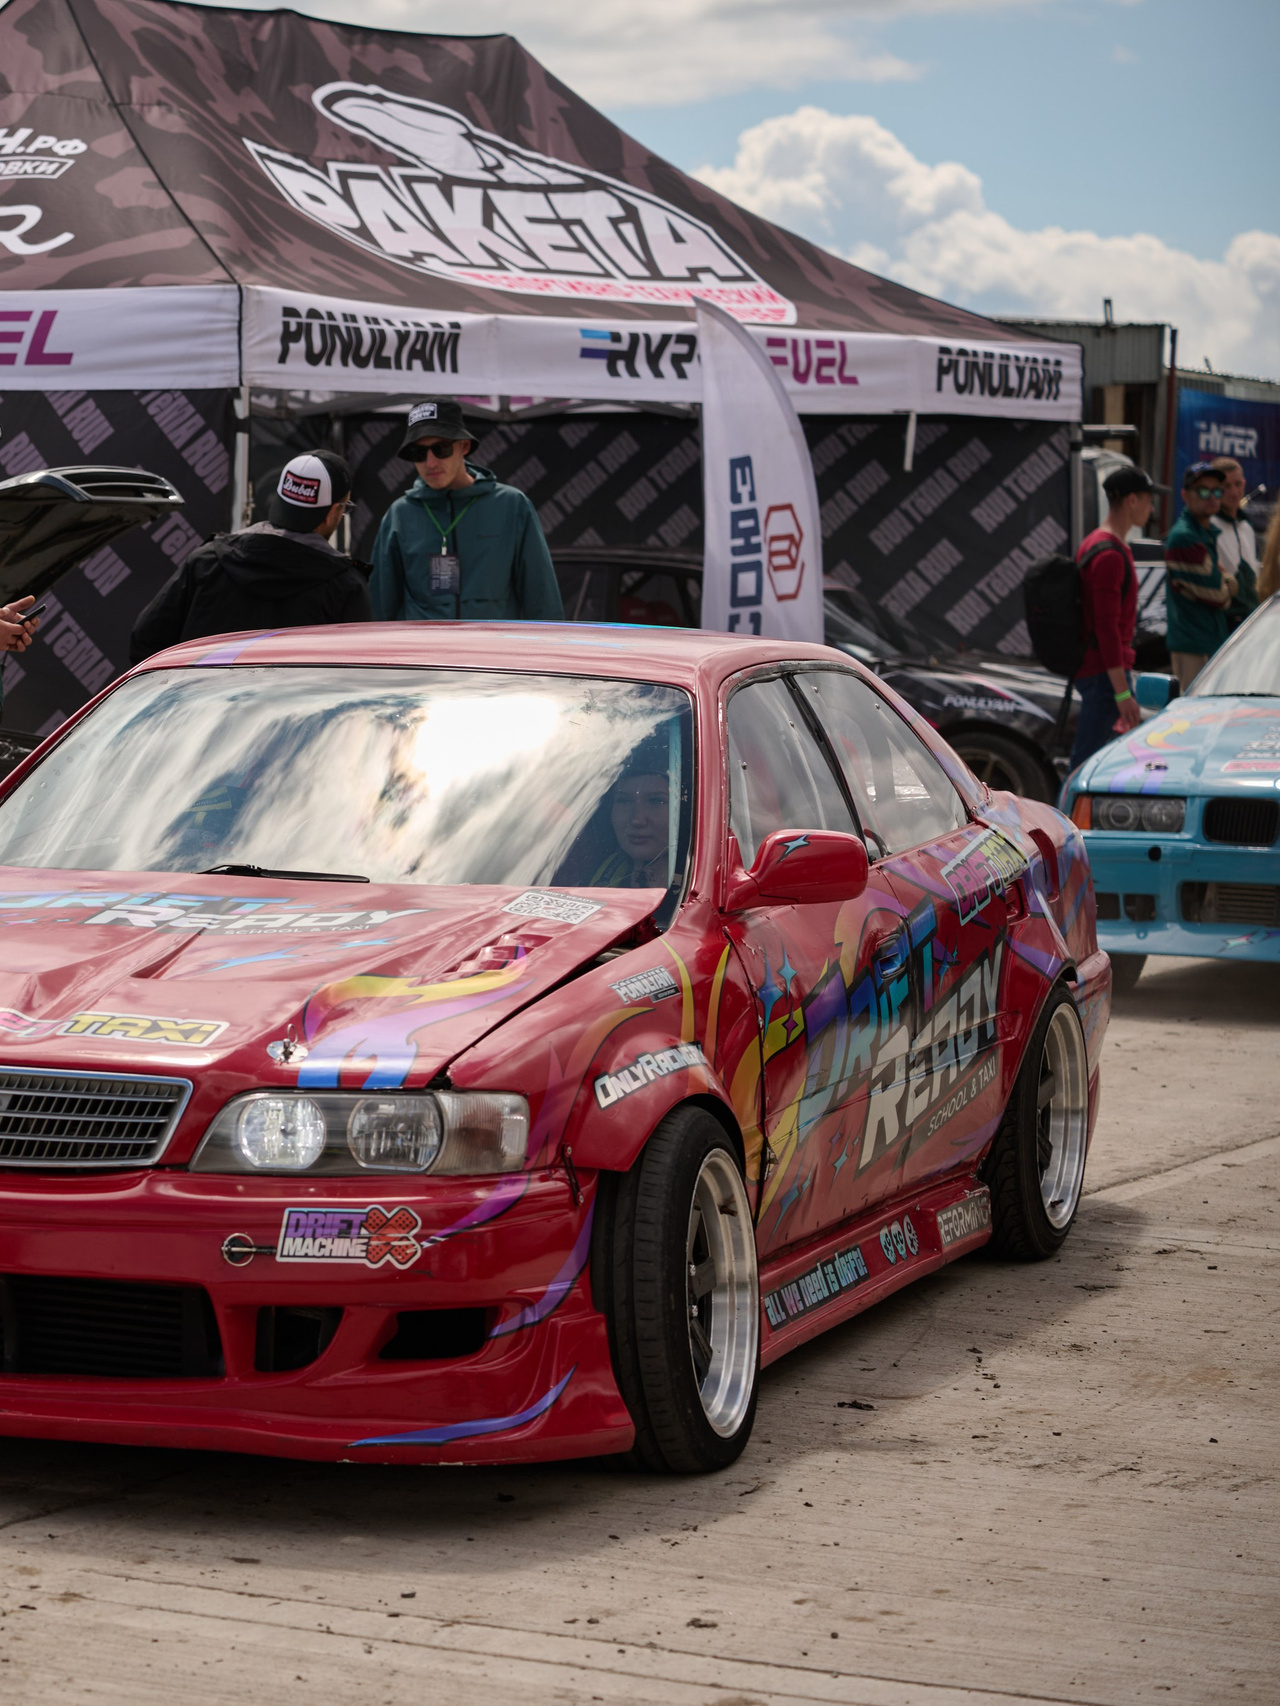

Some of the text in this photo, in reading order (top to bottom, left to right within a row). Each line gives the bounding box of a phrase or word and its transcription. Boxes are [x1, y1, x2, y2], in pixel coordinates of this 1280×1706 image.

[277, 307, 462, 375] PONULYAM
[602, 331, 860, 386] HYP FUEL
[935, 346, 1063, 401] PONULYAM
[283, 478, 318, 498] Dubai
[224, 927, 303, 935] SCHOOL
[65, 1014, 221, 1045] TAXI
[927, 1086, 968, 1137] SCHOOL
[978, 1055, 997, 1090] TAXI
[286, 1211, 368, 1239] DRIFT
[282, 1236, 369, 1258] MACHINE
